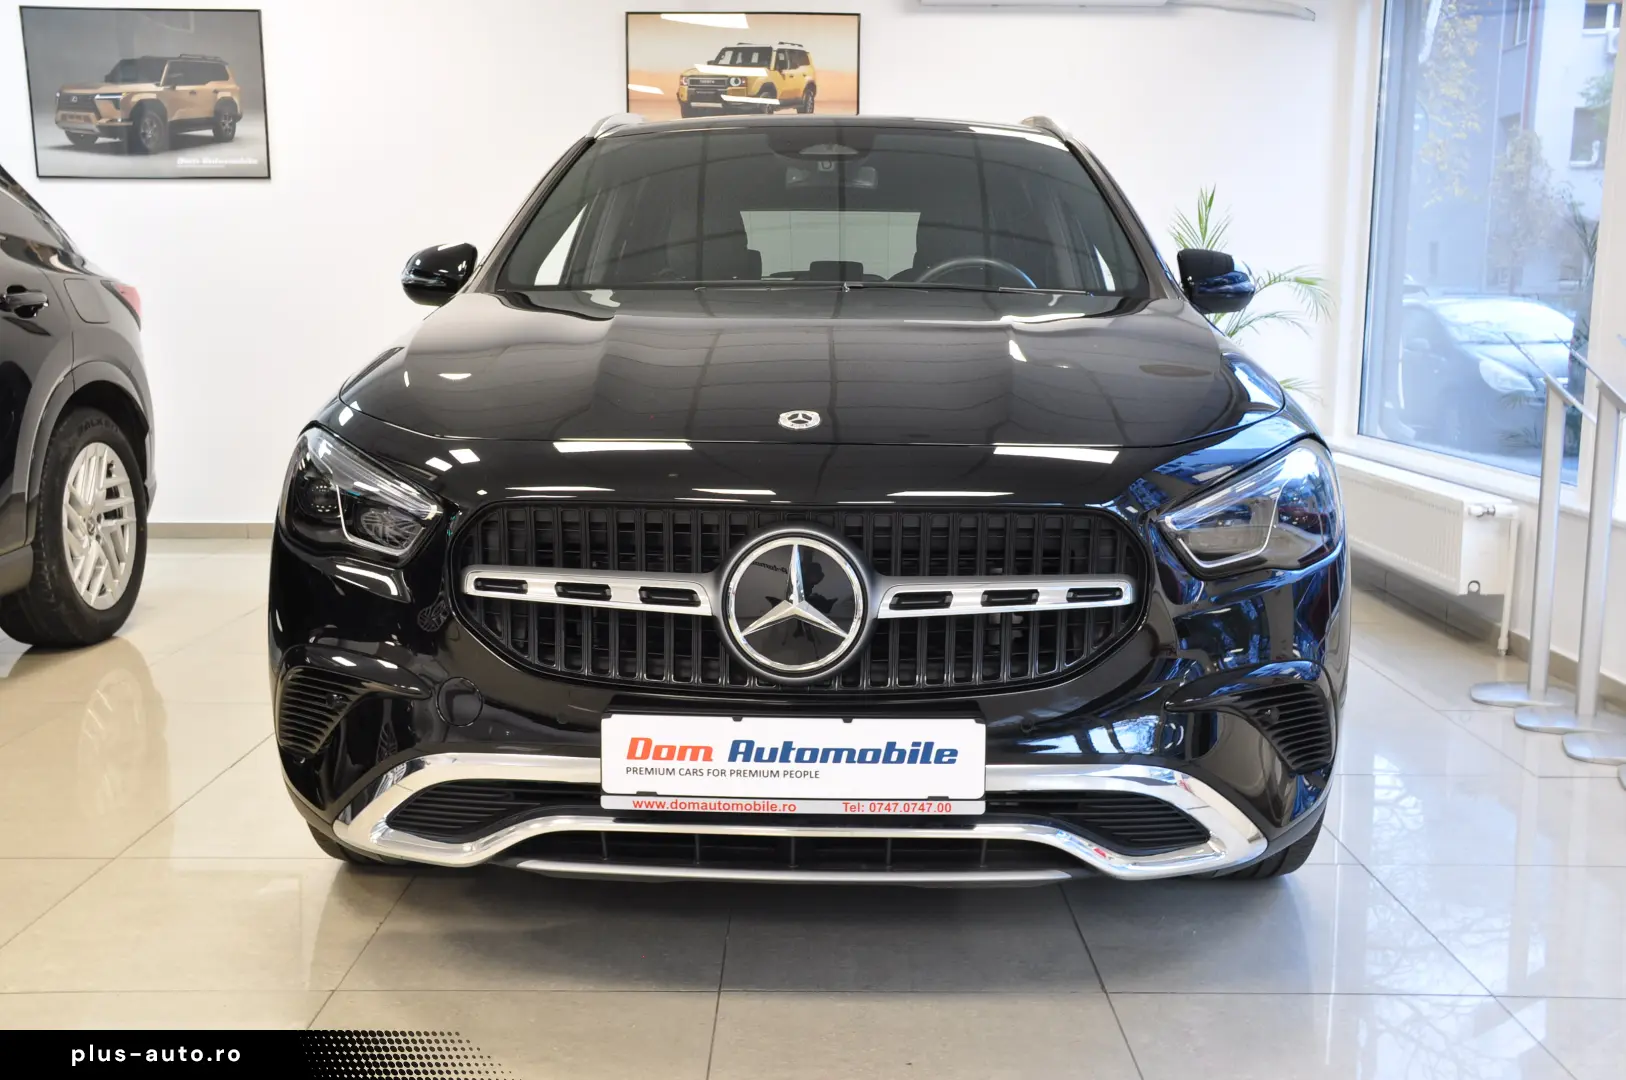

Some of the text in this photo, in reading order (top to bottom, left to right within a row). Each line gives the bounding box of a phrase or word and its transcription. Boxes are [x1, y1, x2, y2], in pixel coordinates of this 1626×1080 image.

[626, 737, 959, 765] Dom Automobile
[626, 766, 820, 779] PREMIUM CARS FOR PREMIUM PEOPLE
[632, 799, 952, 813] www.domautomobile.ro Tel: 0747.0747.00
